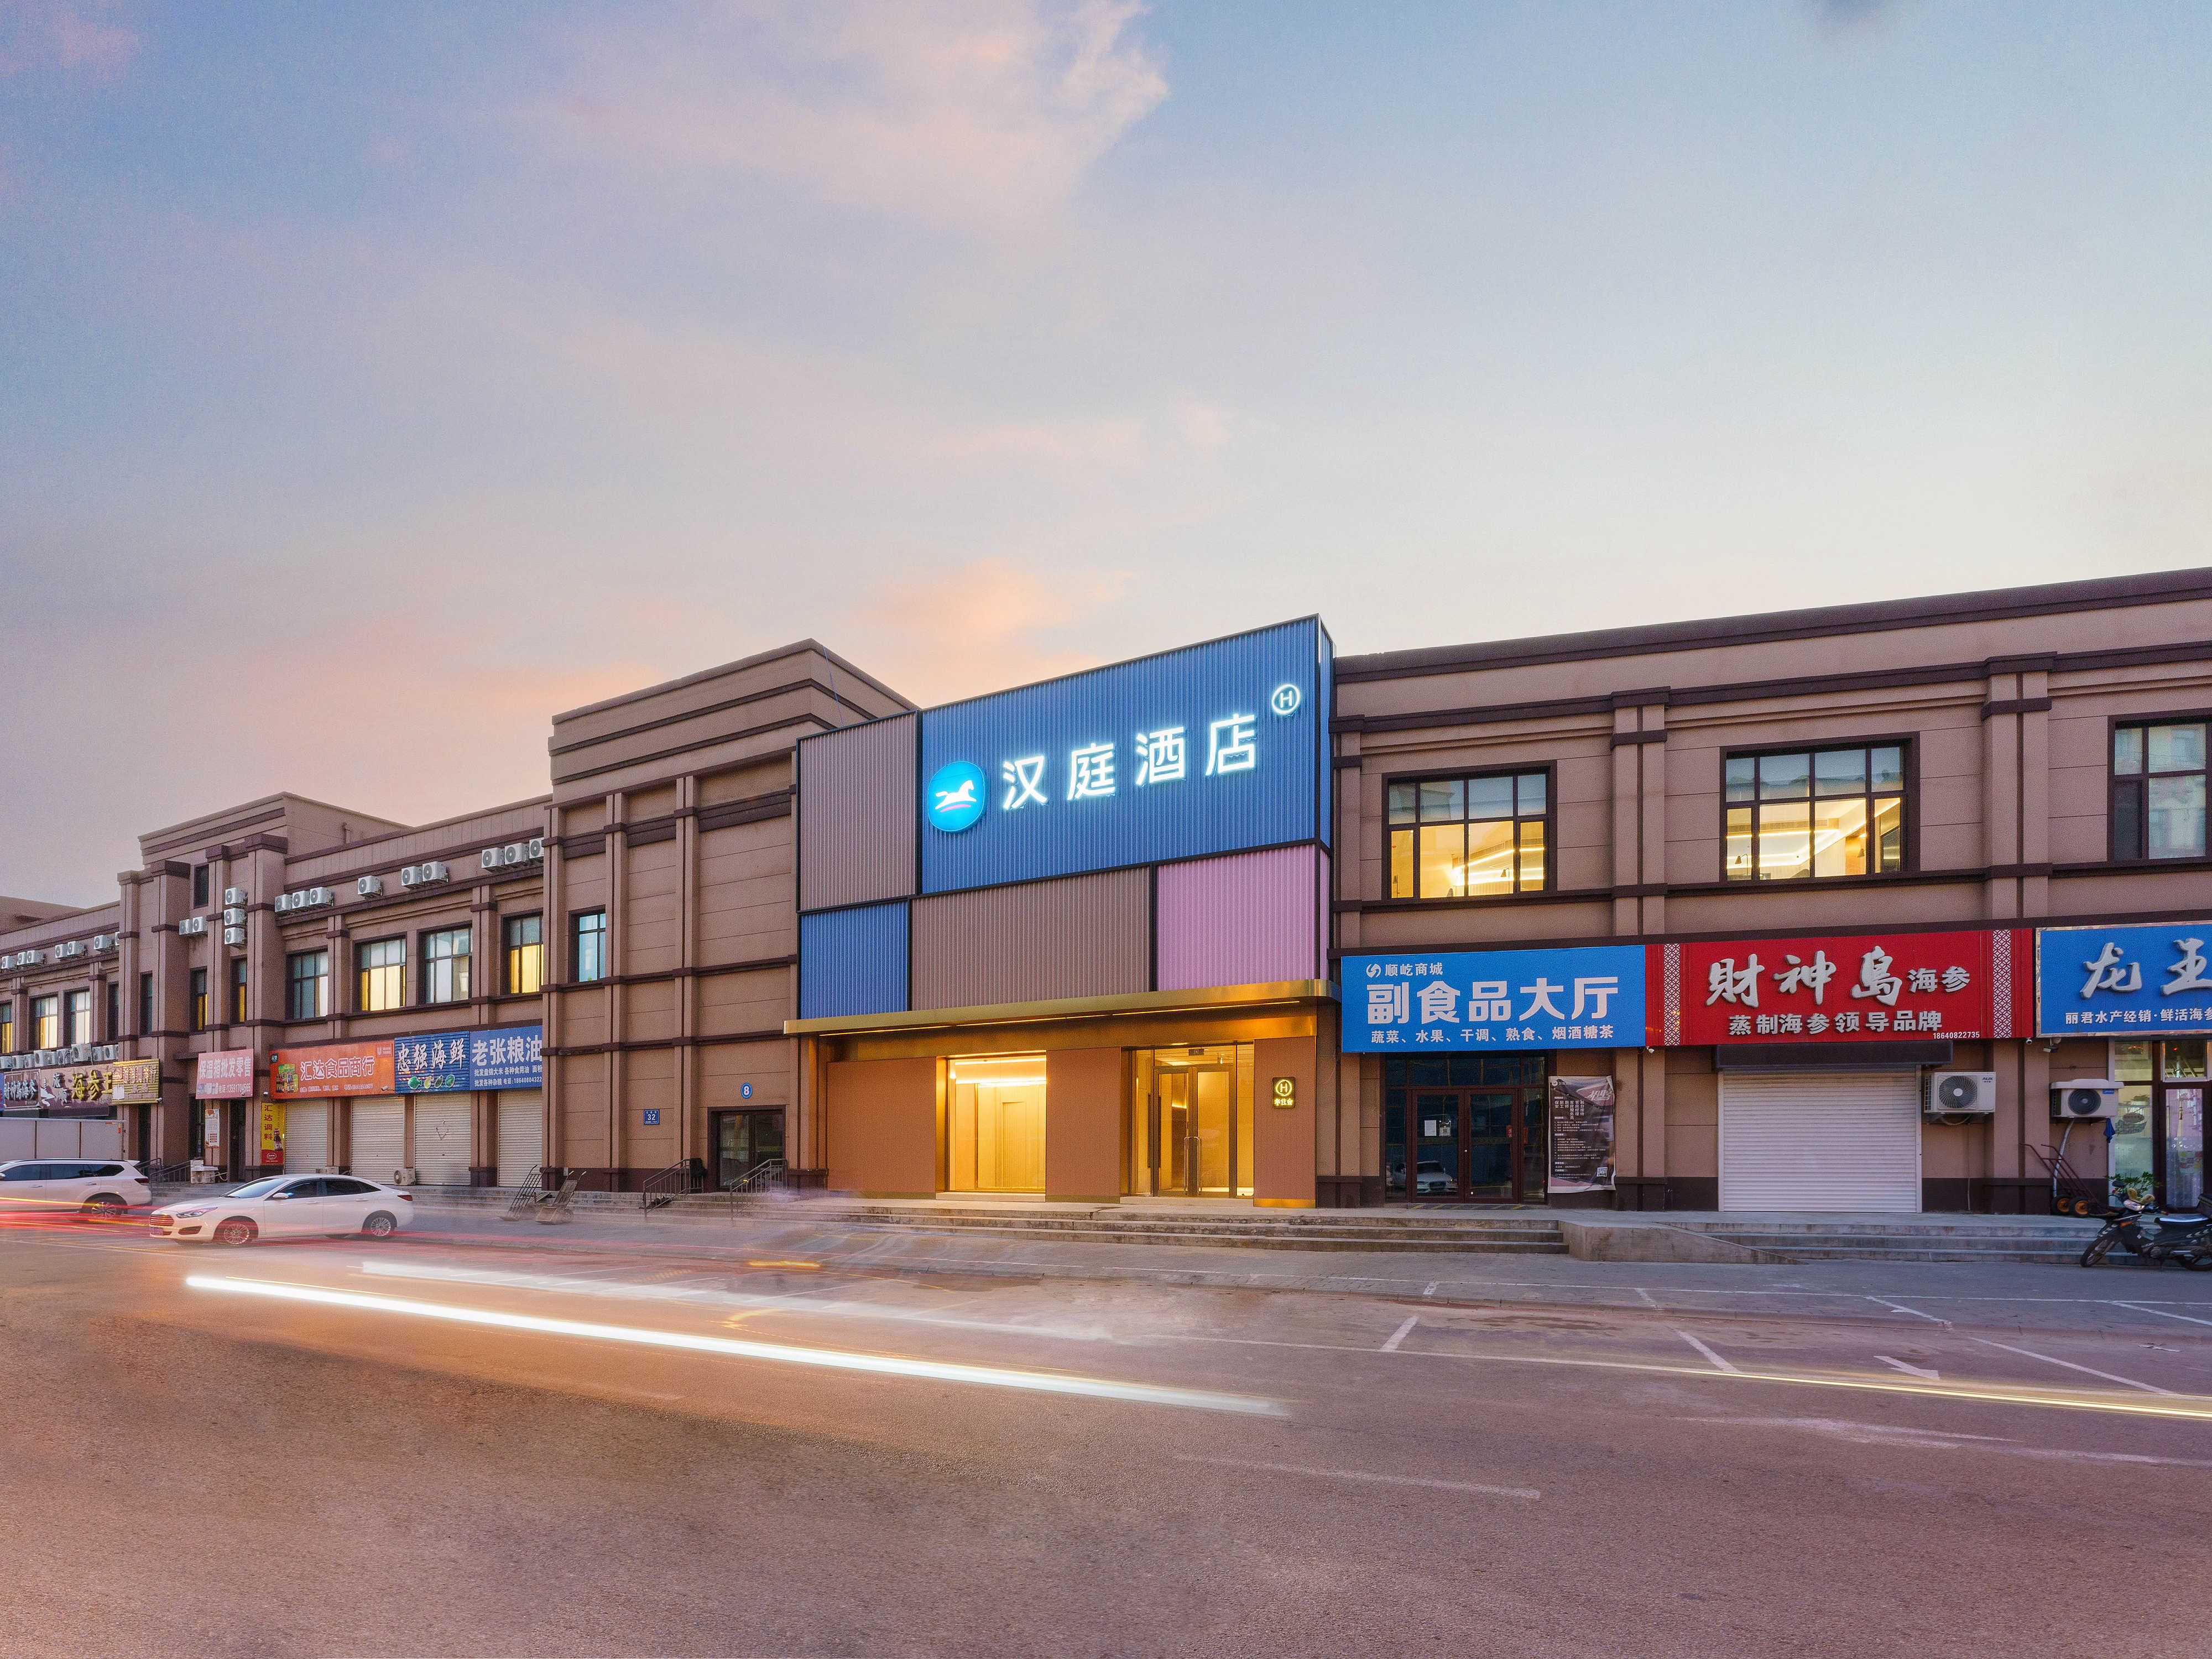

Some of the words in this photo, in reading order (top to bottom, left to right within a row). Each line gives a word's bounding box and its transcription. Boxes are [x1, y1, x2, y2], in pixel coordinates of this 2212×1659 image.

[1002, 713, 1256, 811] 汉庭酒店
[1385, 962, 1443, 977] 顺屹商城
[1366, 976, 1618, 1024] 副食品大厅
[1729, 1010, 1943, 1035] 蒸制海参领导品牌
[1933, 1031, 1980, 1040] 18640822735
[472, 1035, 542, 1066] 老张粮油
[300, 1056, 375, 1082] 汇达食品商行
[743, 1086, 750, 1095] 8
[264, 1104, 273, 1140] 汇达调料
